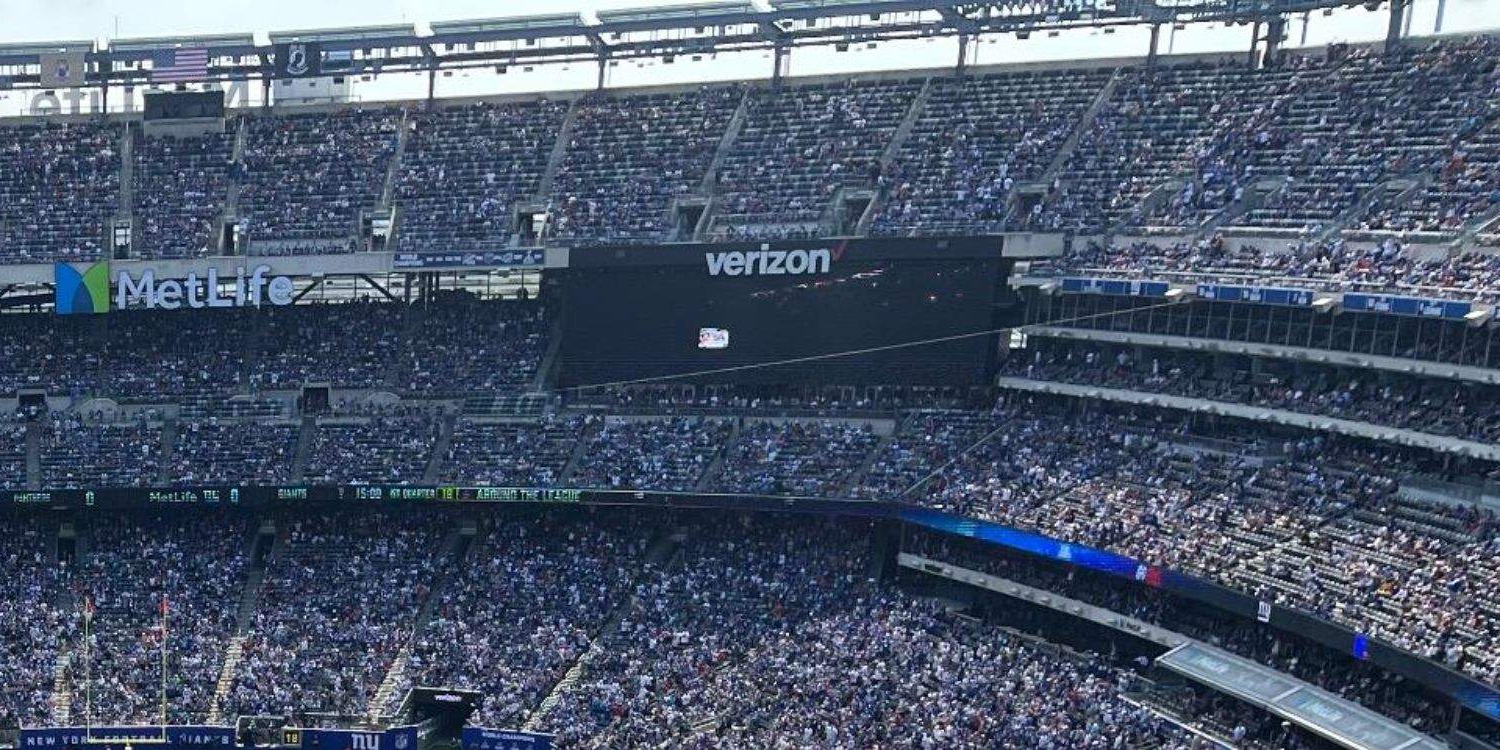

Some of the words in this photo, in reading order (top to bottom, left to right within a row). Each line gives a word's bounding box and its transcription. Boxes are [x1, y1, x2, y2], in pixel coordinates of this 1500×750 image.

[706, 243, 830, 275] verizon
[116, 265, 294, 310] MetLife
[149, 491, 198, 502] MetLife
[277, 488, 307, 499] GIANTS
[355, 488, 382, 499] 15:00
[476, 489, 517, 502] AROUND
[521, 489, 540, 502] THE
[544, 489, 581, 502] LEAGUE
[27, 736, 56, 745] NEW
[104, 735, 172, 745] FOOTBAL
[285, 732, 298, 743] 18
